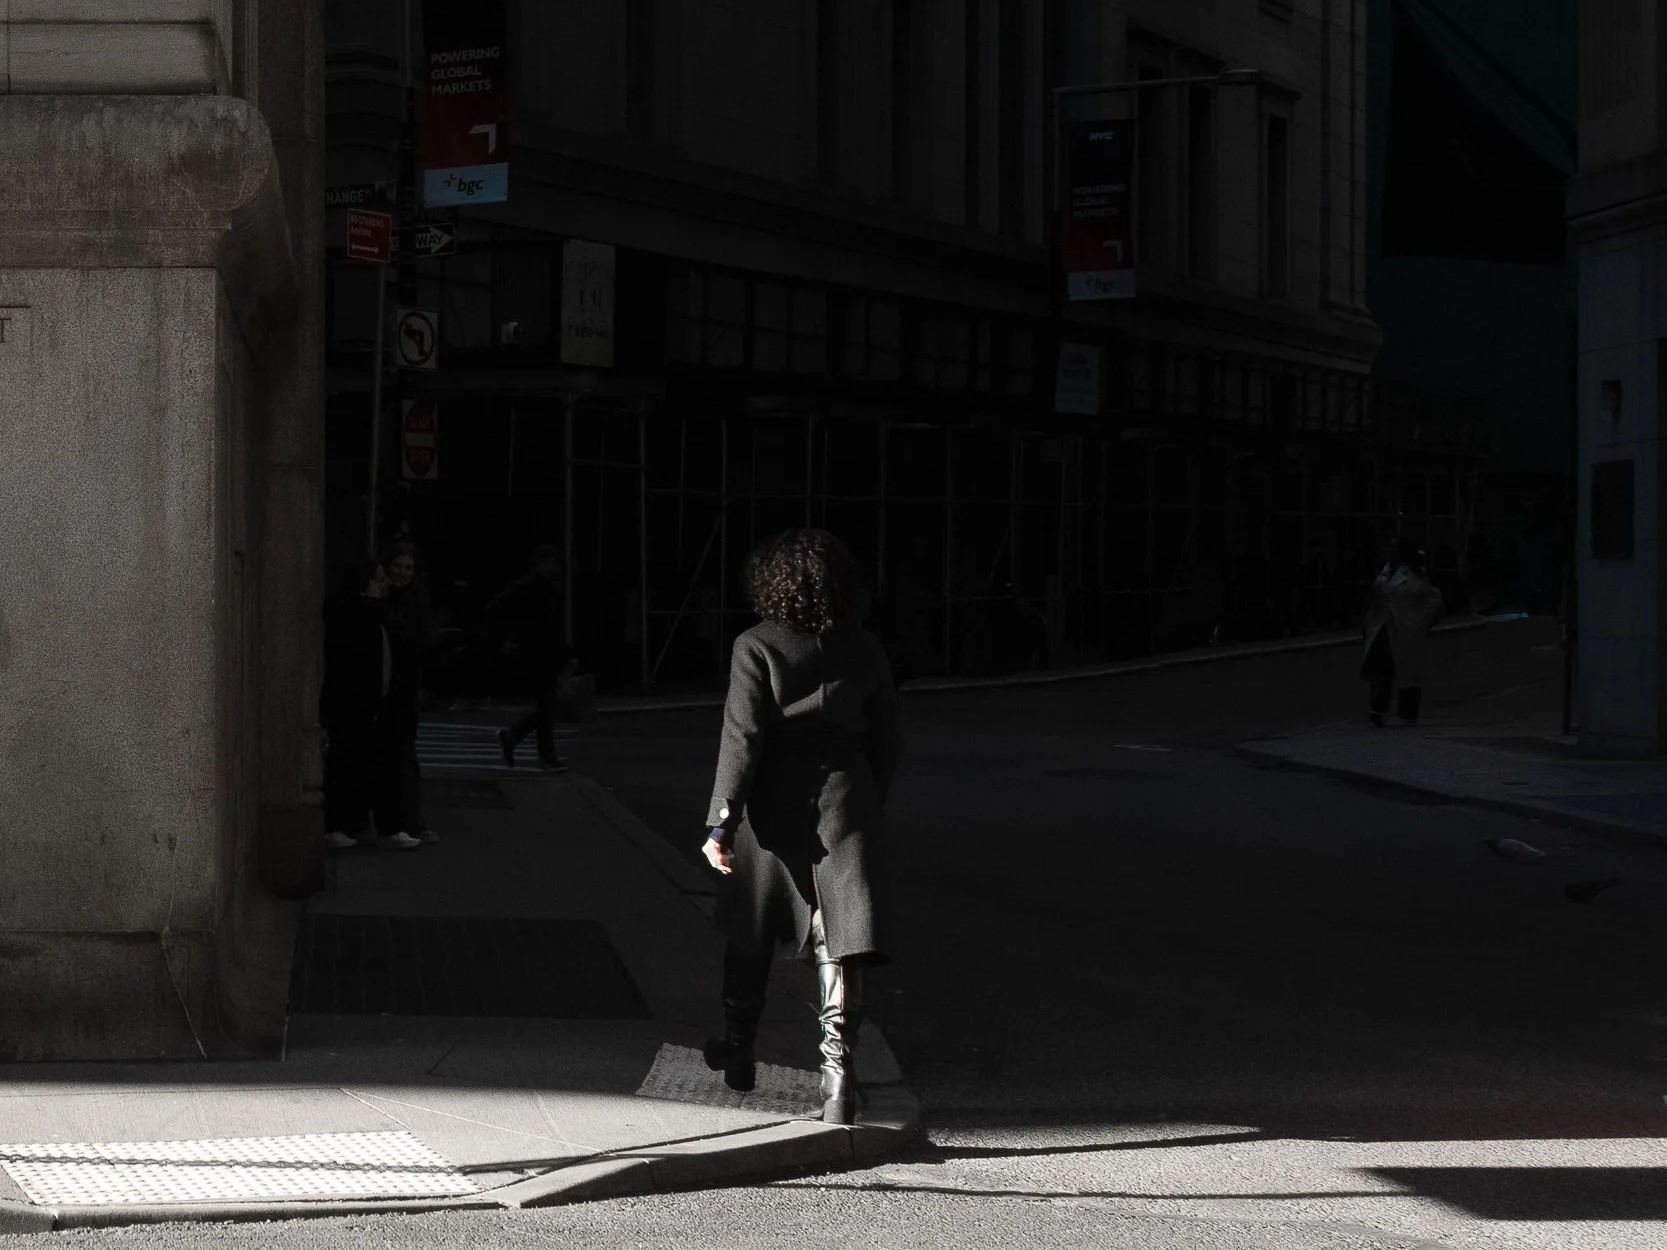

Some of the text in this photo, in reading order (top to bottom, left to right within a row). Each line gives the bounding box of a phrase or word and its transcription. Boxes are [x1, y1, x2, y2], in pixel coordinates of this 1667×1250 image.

[430, 46, 501, 64] POWERING
[431, 65, 483, 80] GLOBAL
[431, 79, 493, 96] MARKETS
[457, 178, 484, 196] bgc
[416, 232, 444, 248] WAY
